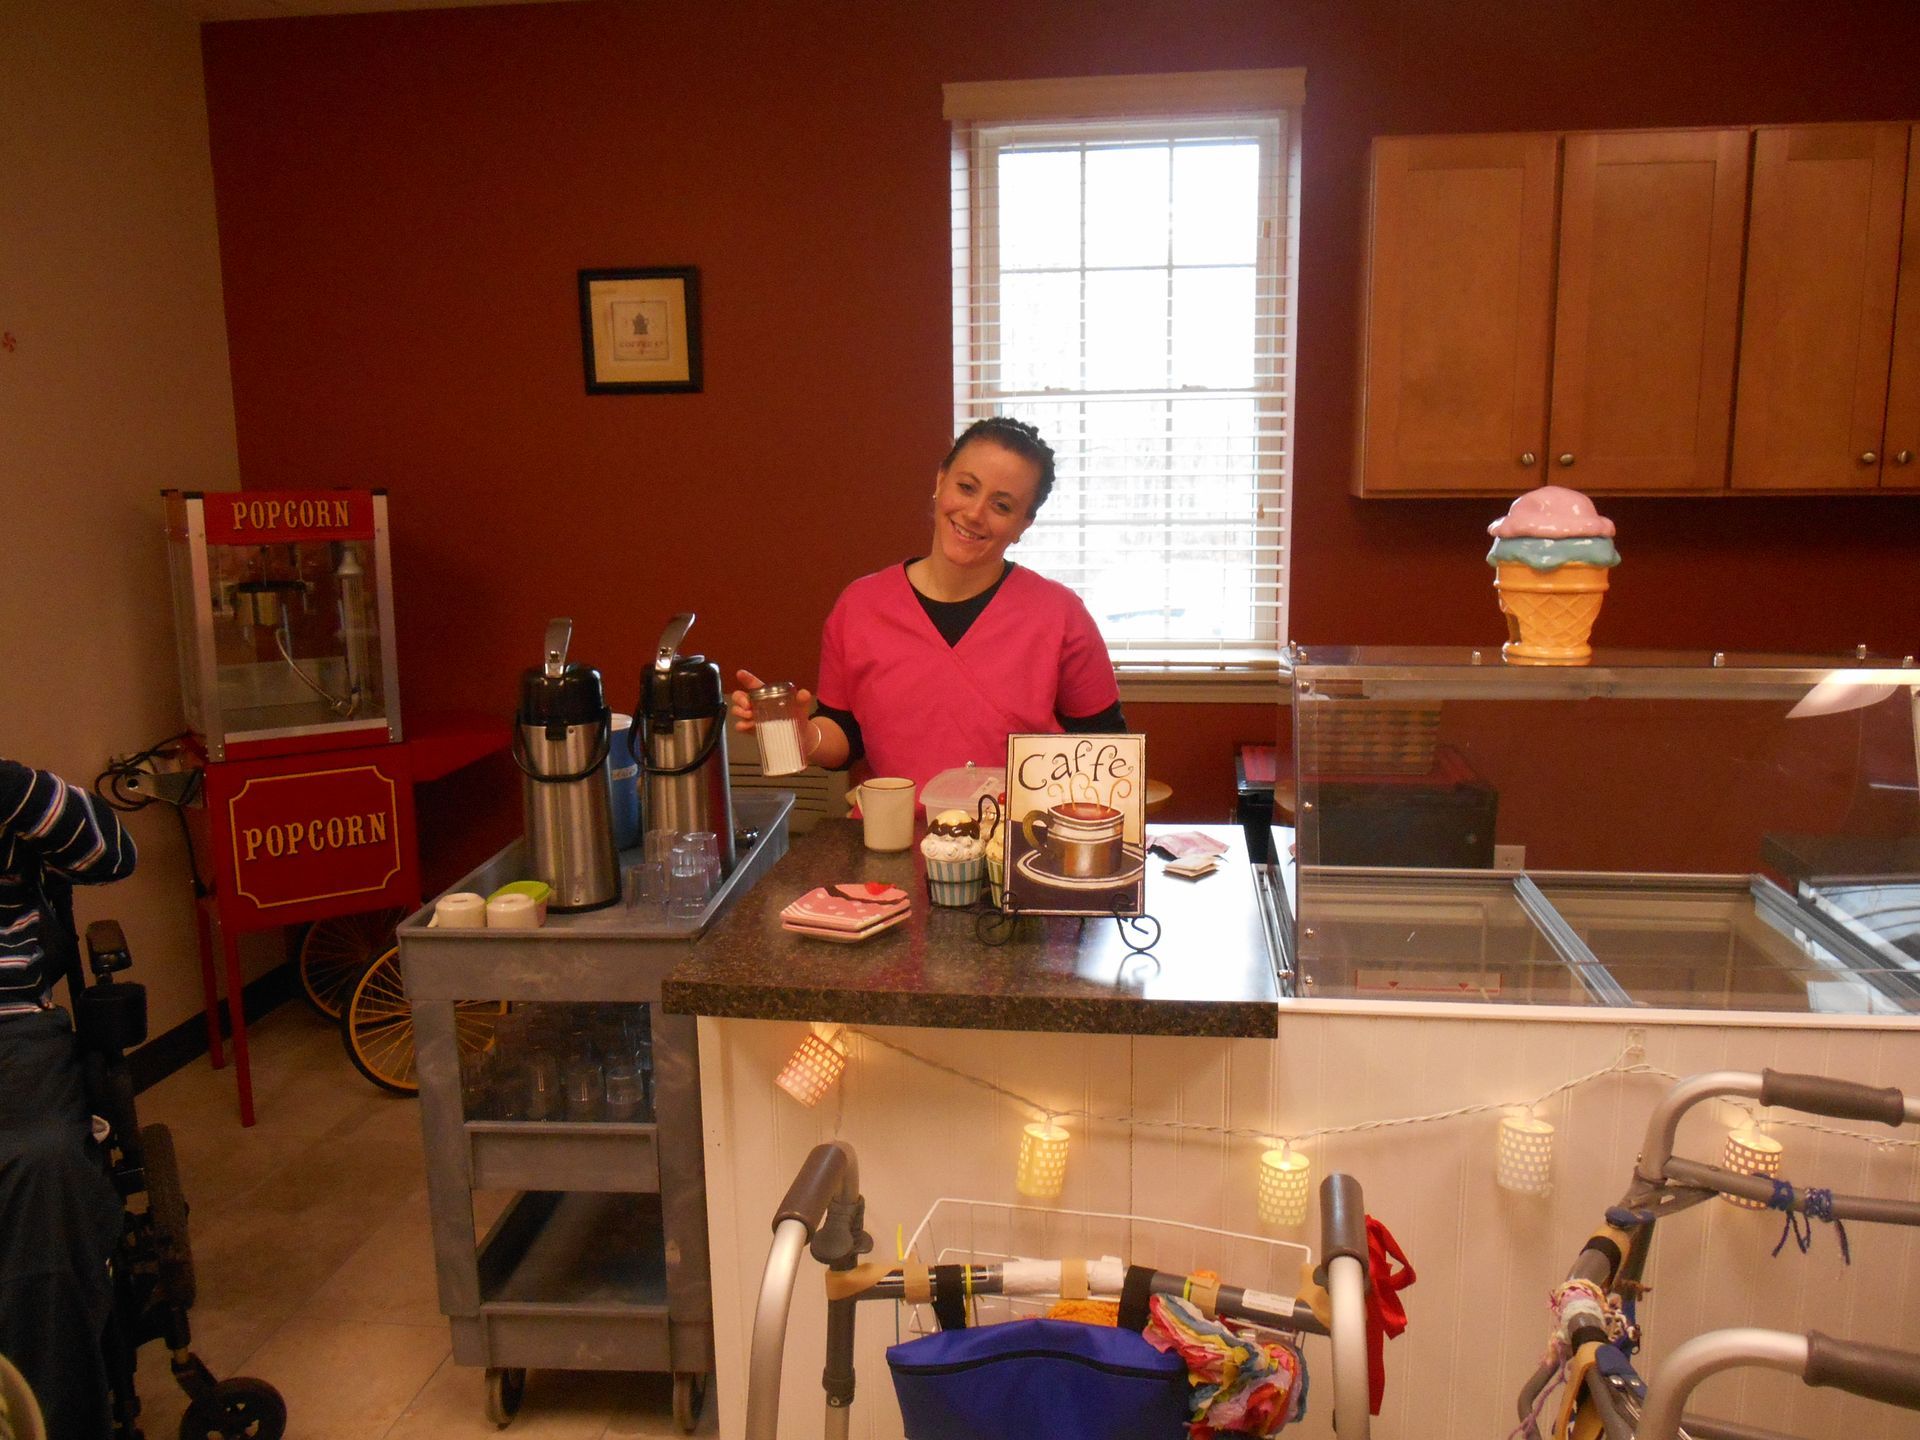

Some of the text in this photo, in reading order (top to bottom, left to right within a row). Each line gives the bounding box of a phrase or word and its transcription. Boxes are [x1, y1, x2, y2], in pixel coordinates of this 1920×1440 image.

[231, 499, 350, 530] POPCORN
[1018, 740, 1134, 790] Caffe
[242, 811, 387, 861] POPCORN
